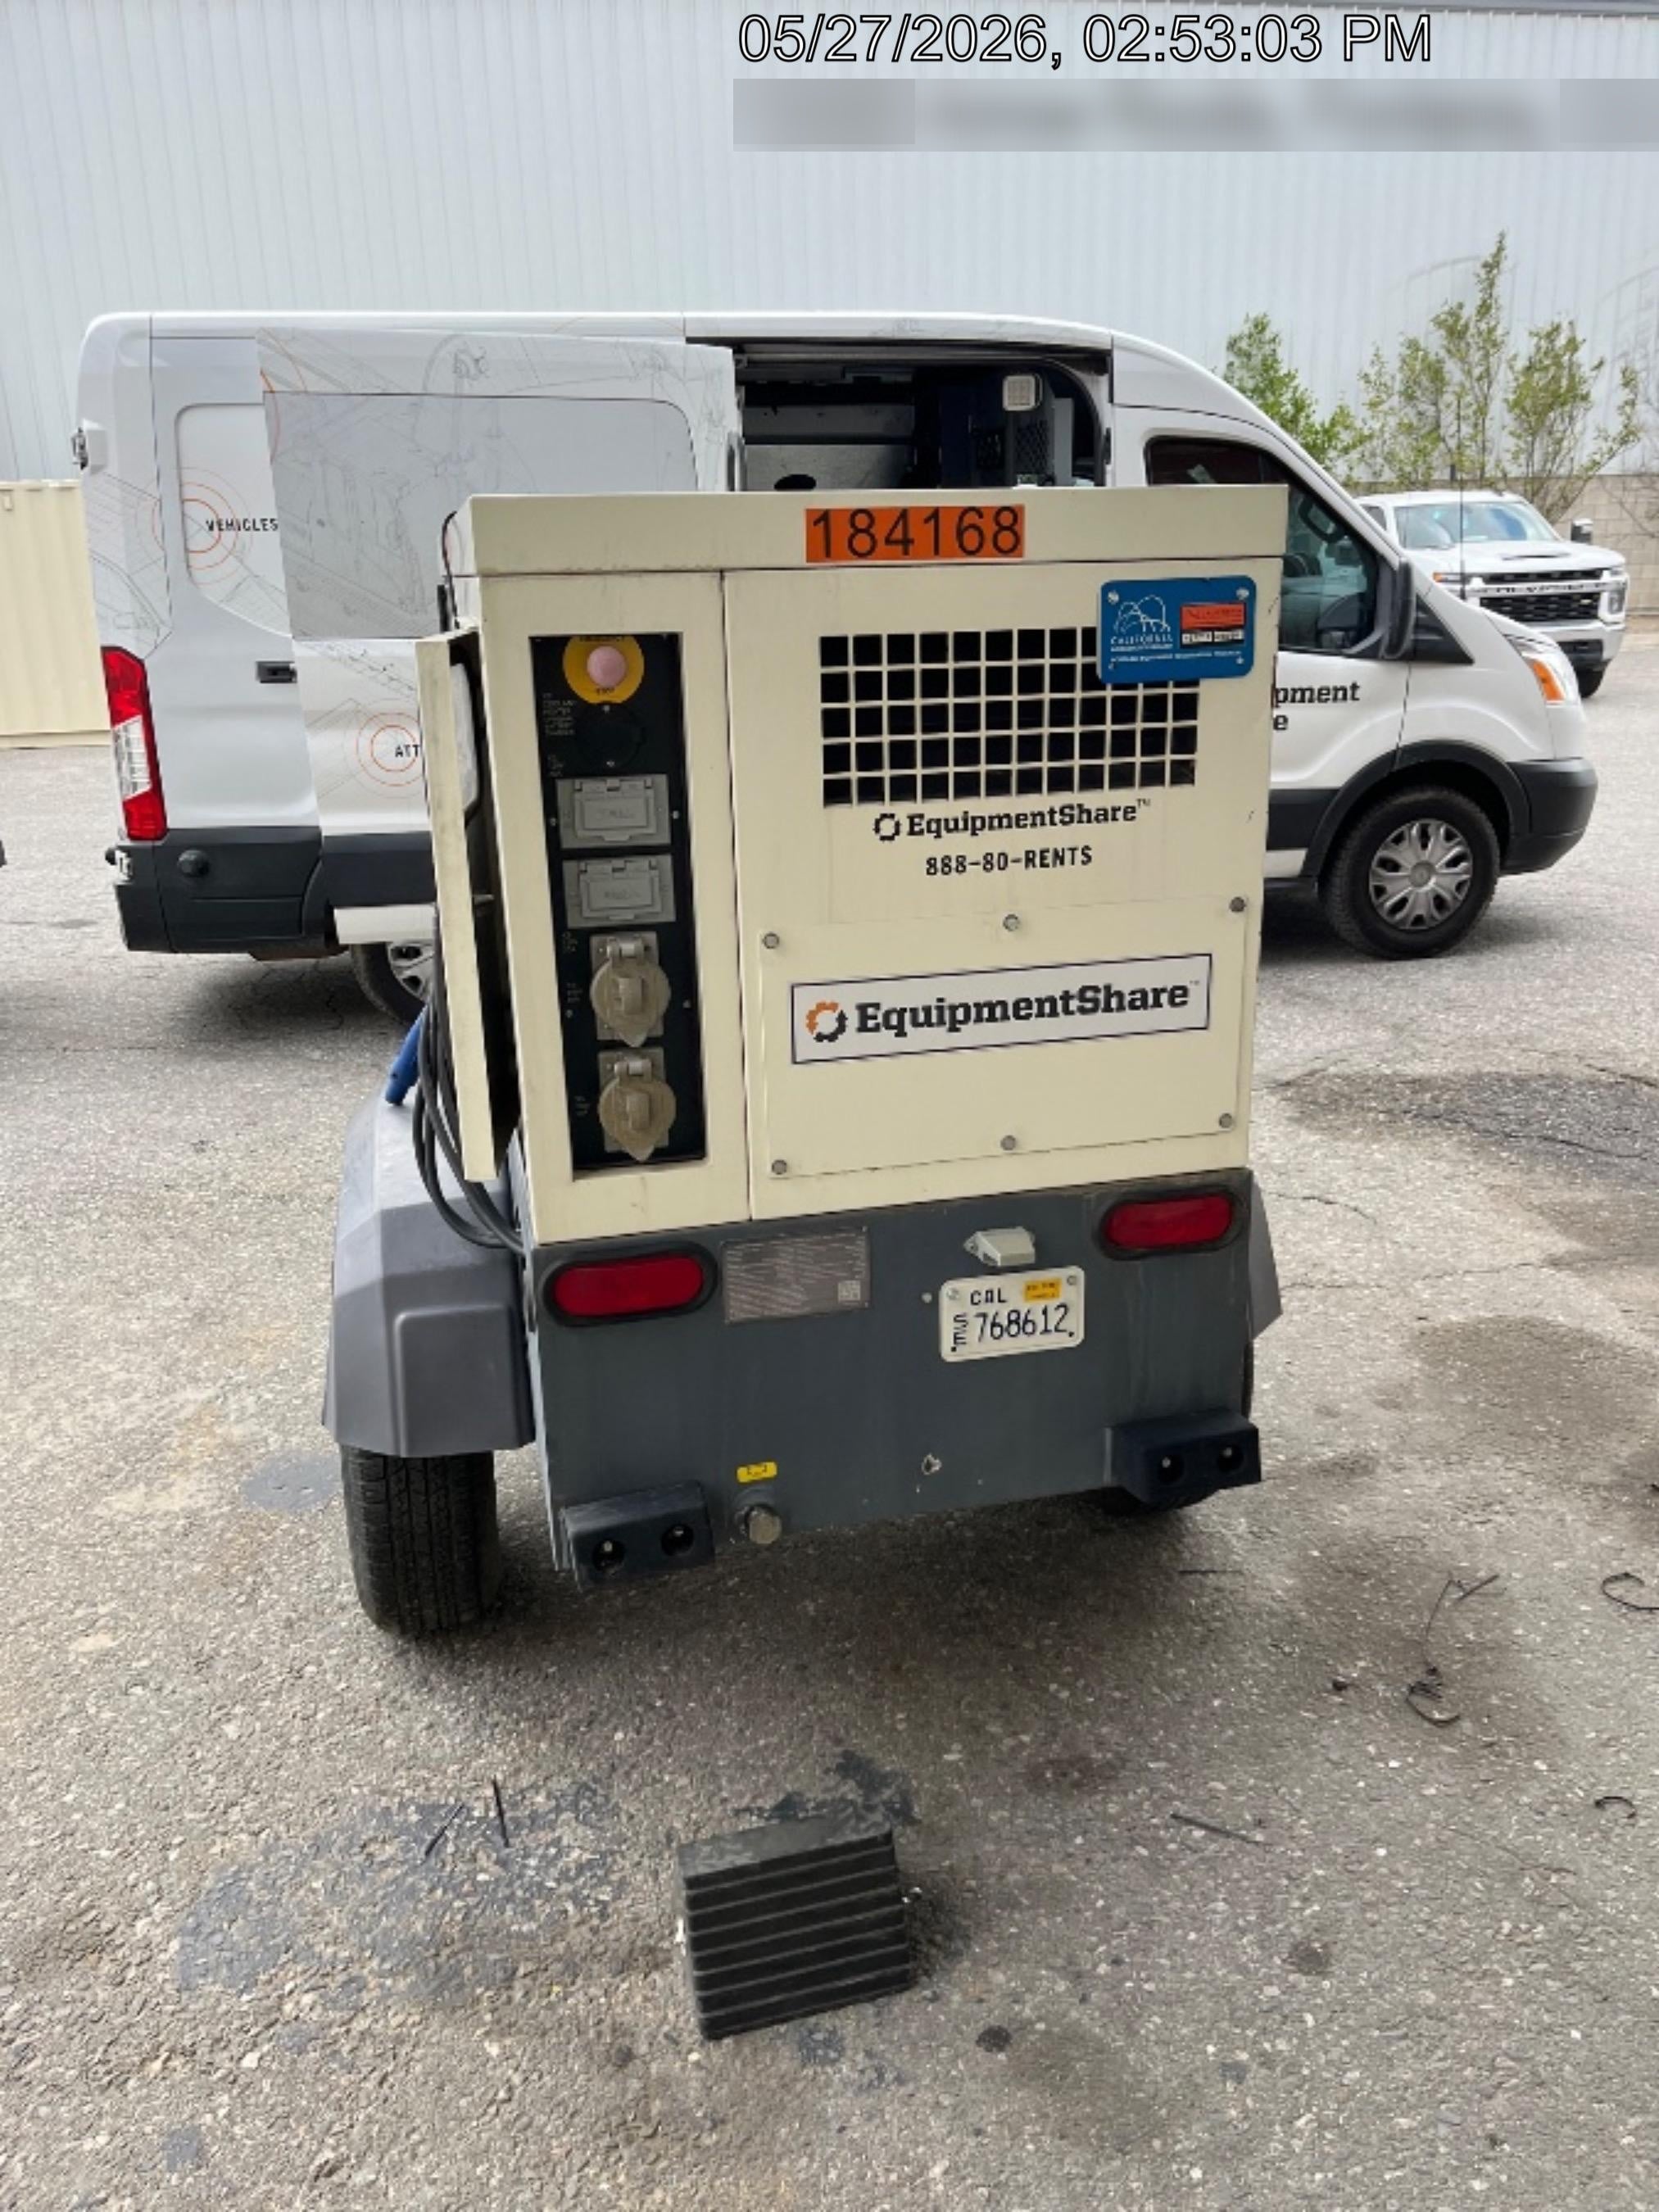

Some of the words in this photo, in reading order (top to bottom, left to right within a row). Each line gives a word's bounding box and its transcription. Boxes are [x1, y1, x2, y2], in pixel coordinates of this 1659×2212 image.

[205, 517, 279, 532] VEHICLES
[812, 505, 1021, 559] 184168
[906, 803, 1138, 840] EquipmentShare
[926, 845, 1094, 877] 888-80-RENTS
[854, 983, 1190, 1038] EquipmentShare
[970, 1288, 1009, 1306] CAL
[974, 1303, 1070, 1344] 768612
